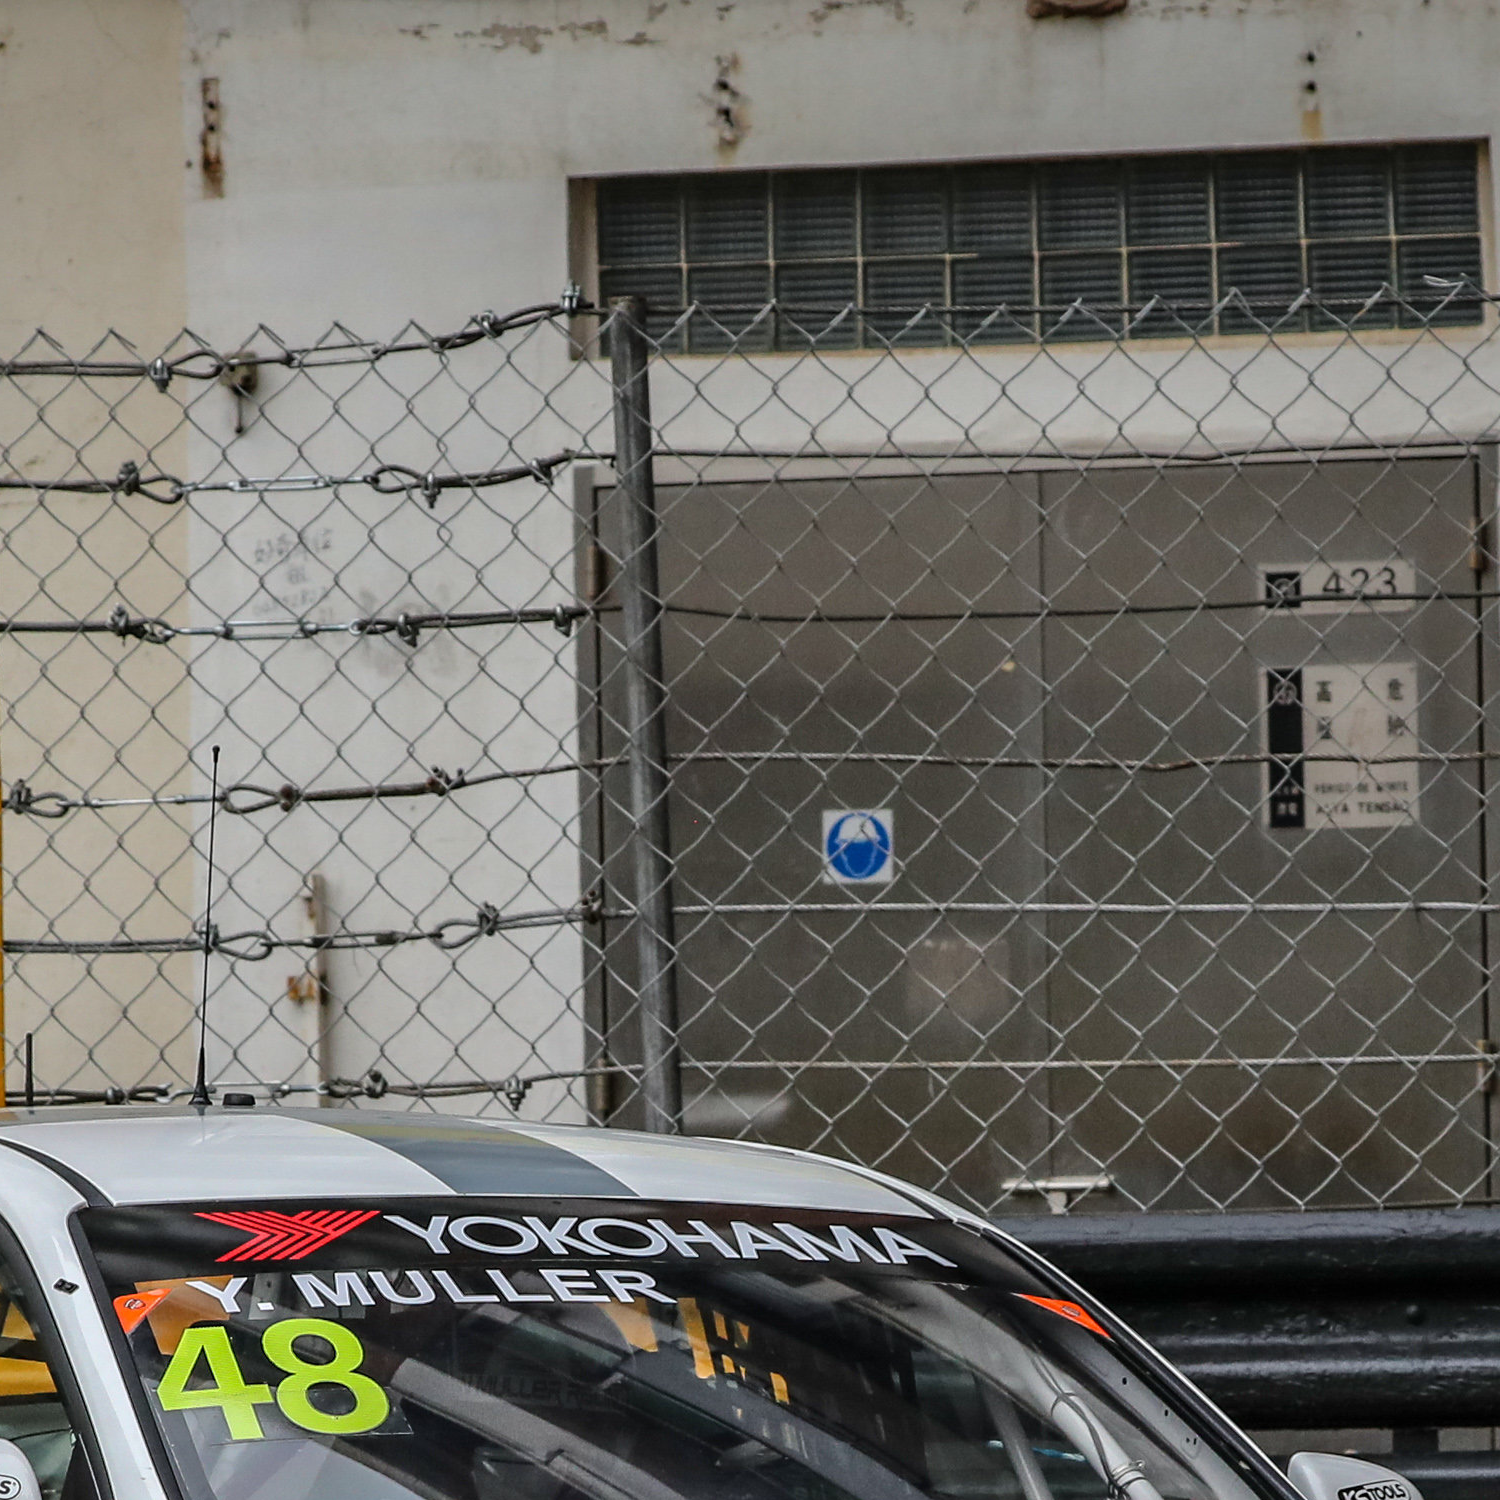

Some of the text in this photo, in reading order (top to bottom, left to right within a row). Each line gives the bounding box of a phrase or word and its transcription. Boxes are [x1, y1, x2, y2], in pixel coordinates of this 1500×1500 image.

[1322, 566, 1398, 598] 423
[383, 1214, 958, 1269] YOKOHAMA
[187, 1267, 678, 1314] Y. MULLER
[157, 1317, 391, 1441] 48
